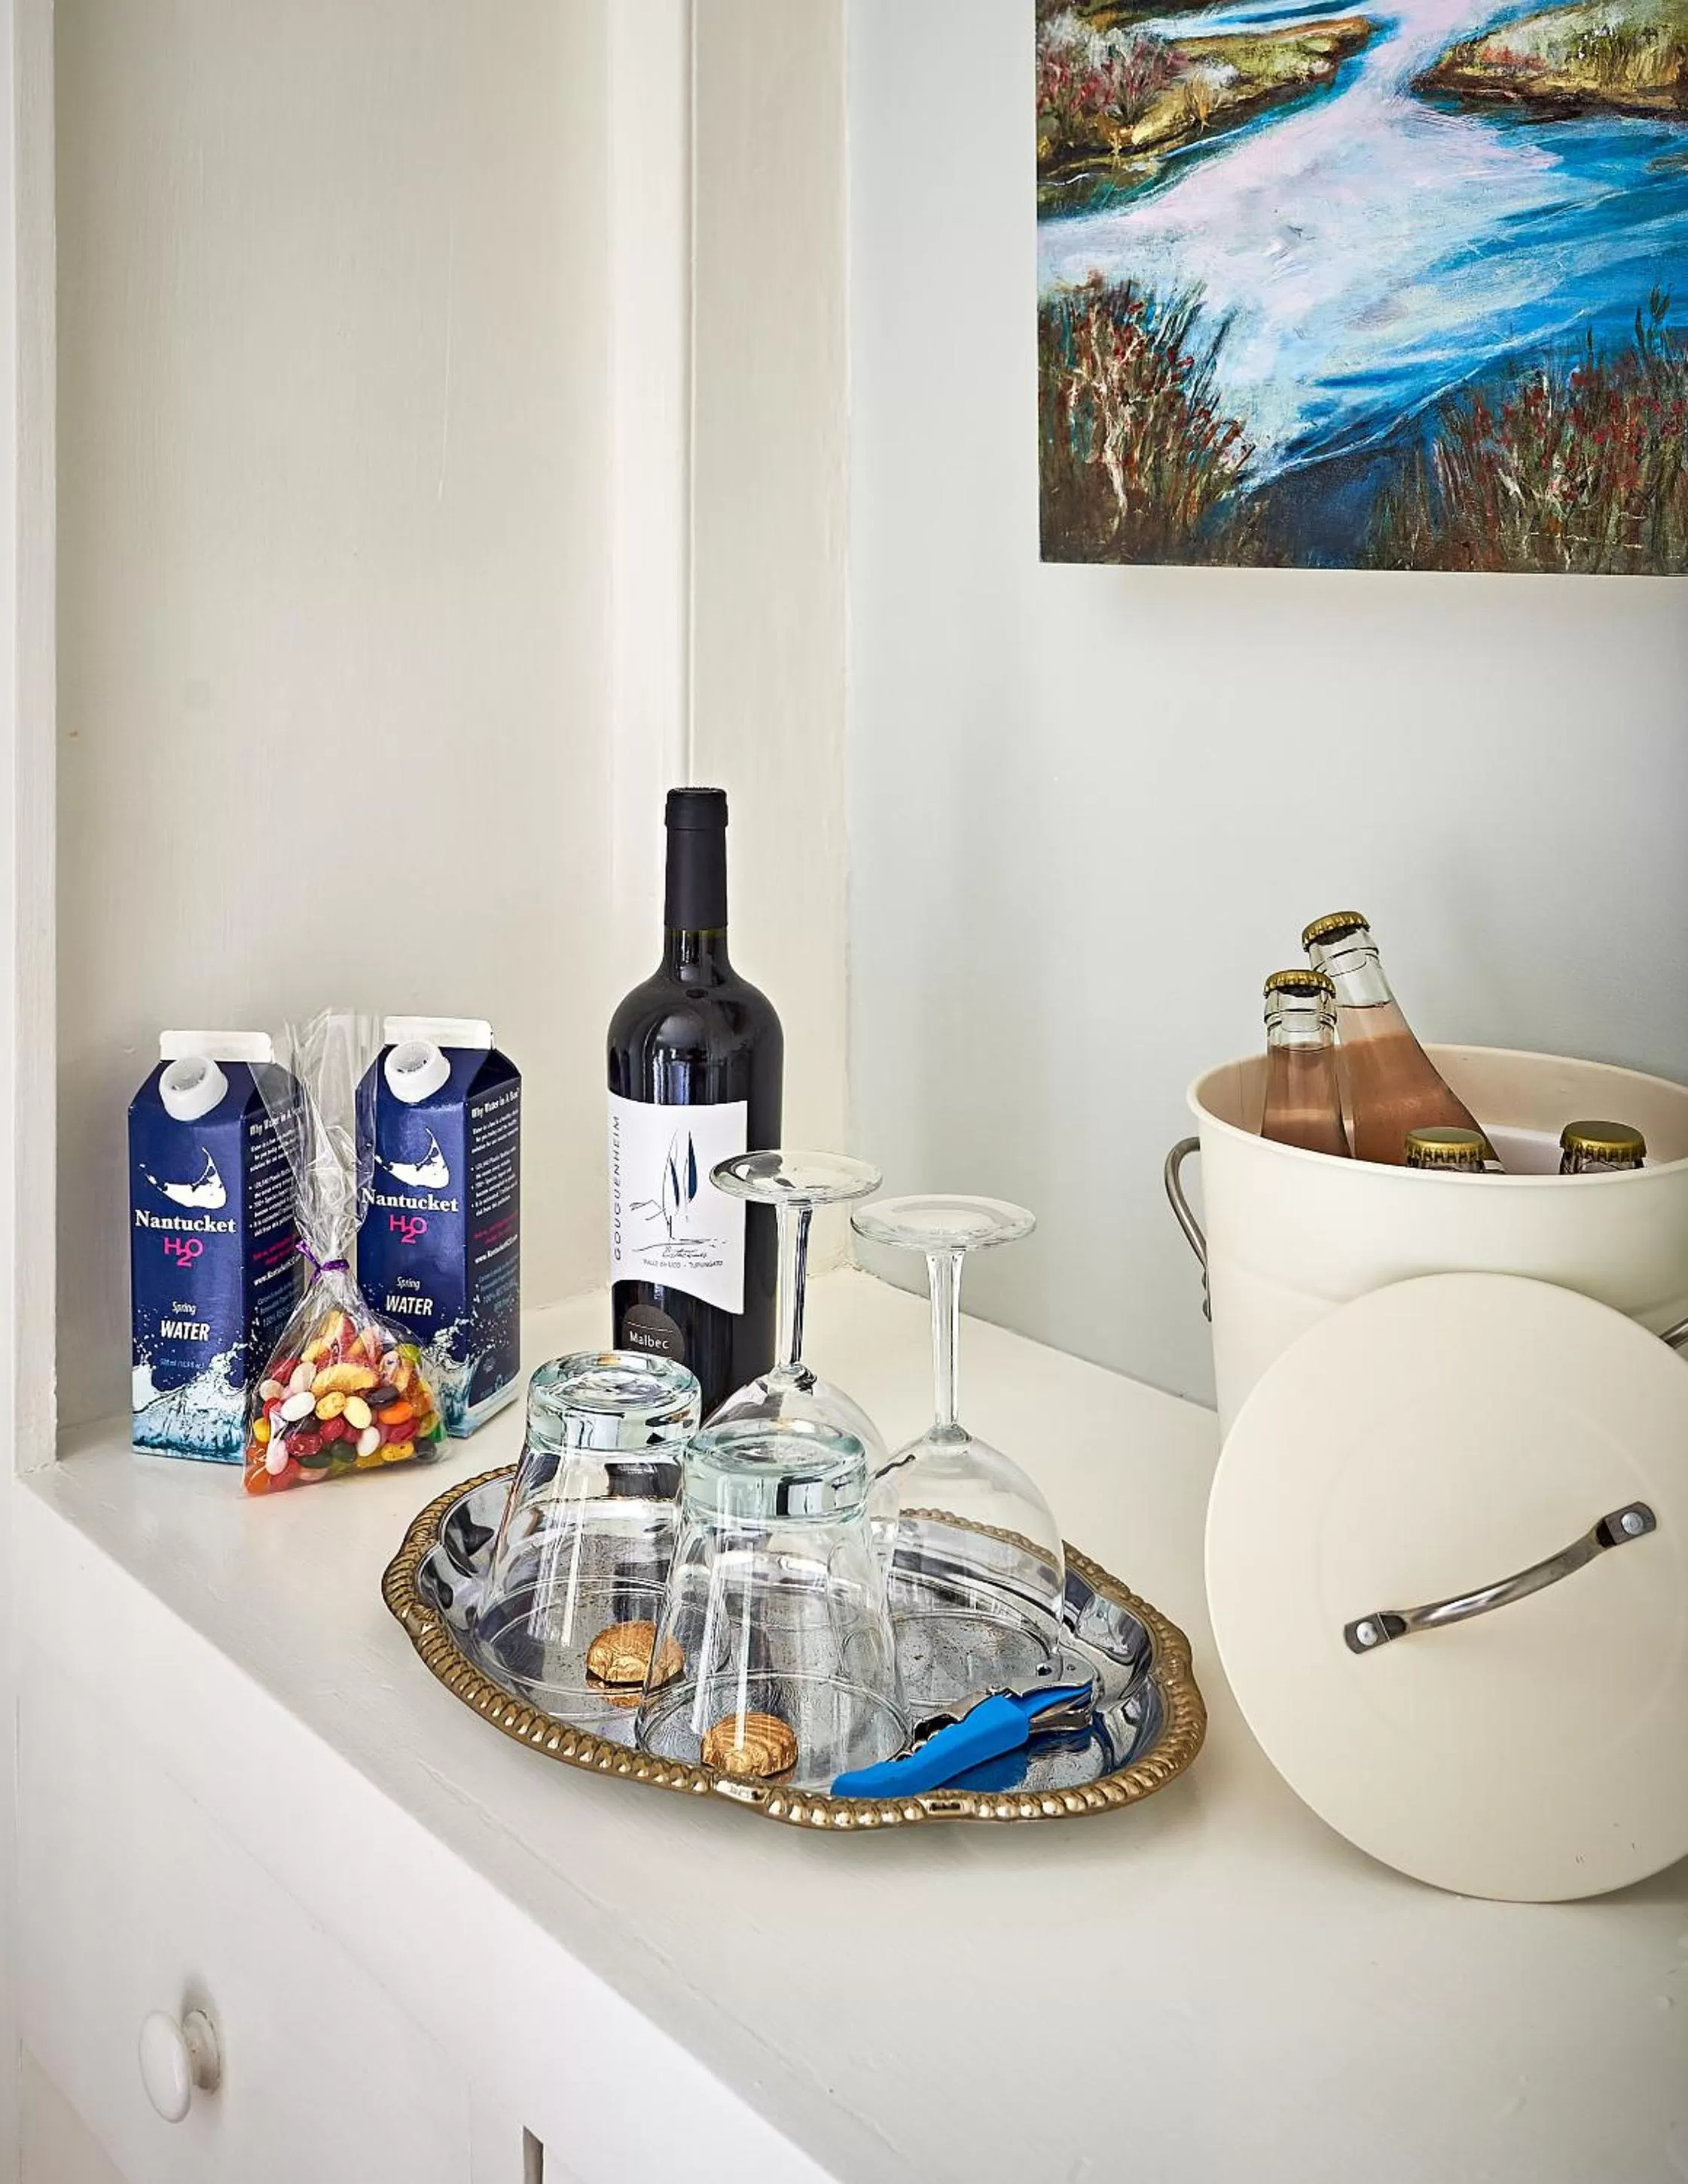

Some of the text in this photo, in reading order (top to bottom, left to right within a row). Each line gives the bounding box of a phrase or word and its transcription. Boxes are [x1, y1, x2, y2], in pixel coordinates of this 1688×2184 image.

[612, 1115, 621, 1261] GOUGUENHEIM
[361, 1188, 459, 1212] Nantucket
[135, 1209, 237, 1233] Nantucket
[396, 1277, 421, 1291] Spring
[172, 1301, 198, 1316] Spring
[386, 1295, 433, 1316] WATER
[160, 1320, 210, 1341] WATER
[630, 1331, 670, 1350] Malbec
